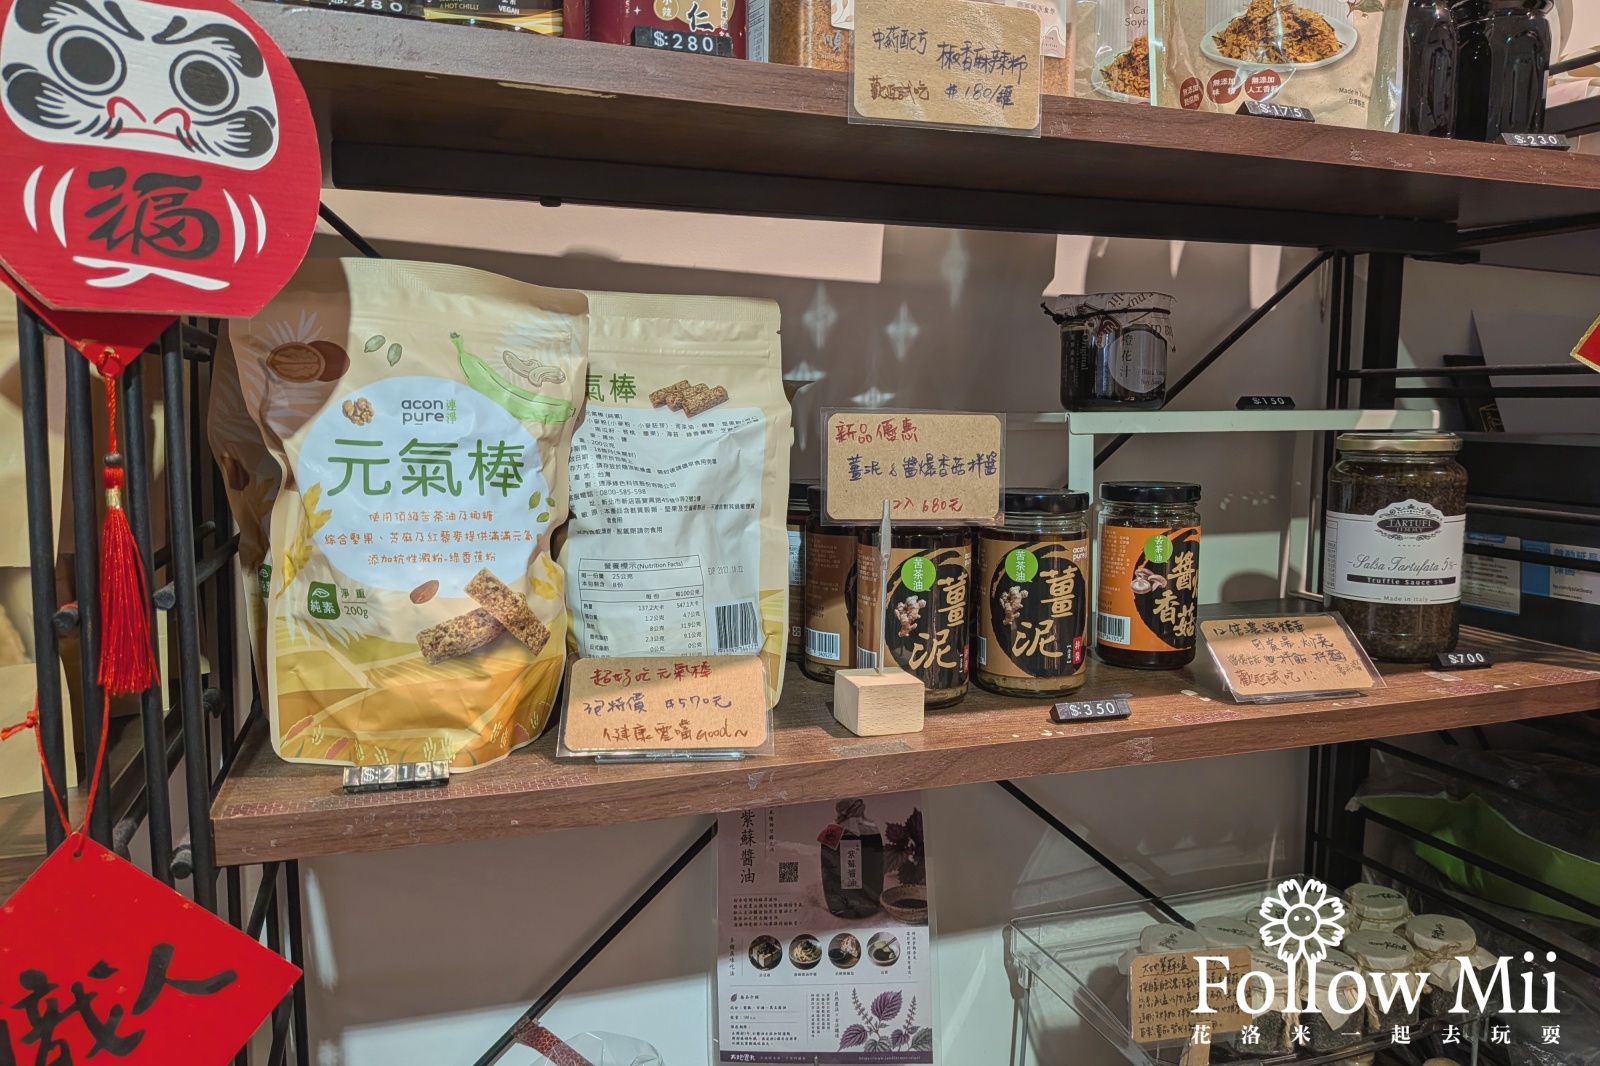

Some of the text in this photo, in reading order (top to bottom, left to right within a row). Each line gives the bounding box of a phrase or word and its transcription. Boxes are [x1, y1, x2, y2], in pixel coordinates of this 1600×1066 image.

[498, 5, 520, 15] VEGAN
[687, 2, 715, 32] 仁
[1251, 76, 1275, 85] 無添加
[85, 165, 221, 261] 福
[1120, 334, 1133, 378] 橙花汁
[401, 399, 443, 411] acon
[403, 411, 444, 425] pure
[835, 417, 918, 444] 新品優惠
[327, 438, 526, 498] 元氣棒
[1388, 518, 1432, 528] TARTUFI
[1154, 536, 1164, 563] 苦茶油
[912, 558, 924, 591] 苦茶油
[1015, 550, 1026, 582] 苦茶油
[1388, 556, 1440, 576] Tartufata
[1367, 577, 1400, 585] Truffle
[310, 600, 336, 614] 純素
[1413, 595, 1429, 603] Italy
[344, 606, 369, 619] 200g
[909, 571, 968, 671] 薑泥
[1011, 566, 1078, 658] 薑泥
